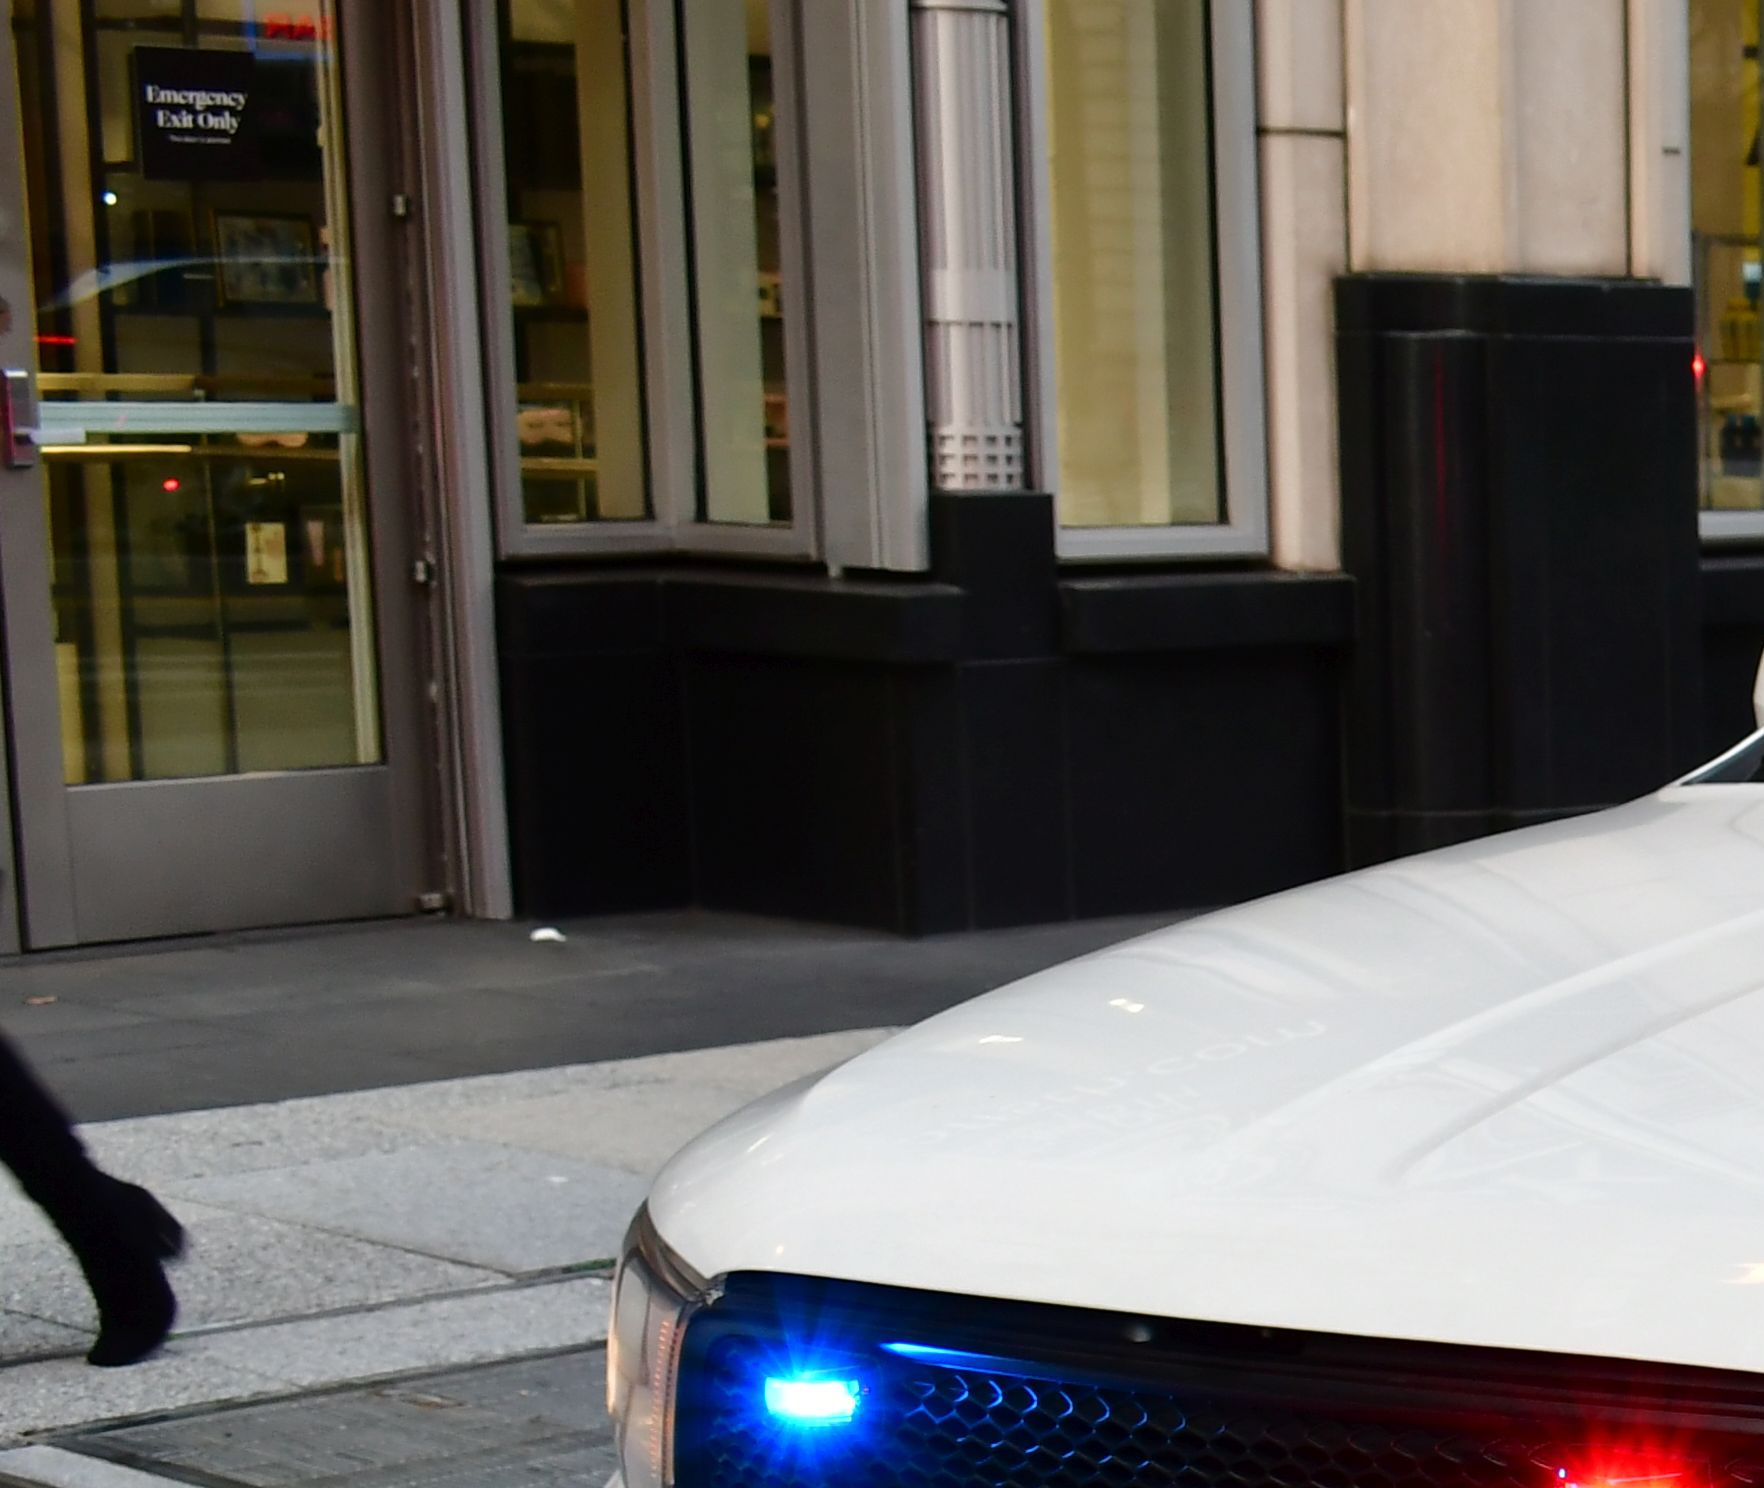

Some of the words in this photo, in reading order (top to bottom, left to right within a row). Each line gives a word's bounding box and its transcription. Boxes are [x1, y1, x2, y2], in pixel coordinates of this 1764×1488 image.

[146, 85, 248, 110] Emergency
[157, 109, 194, 128] Exit
[197, 110, 240, 134] Only
